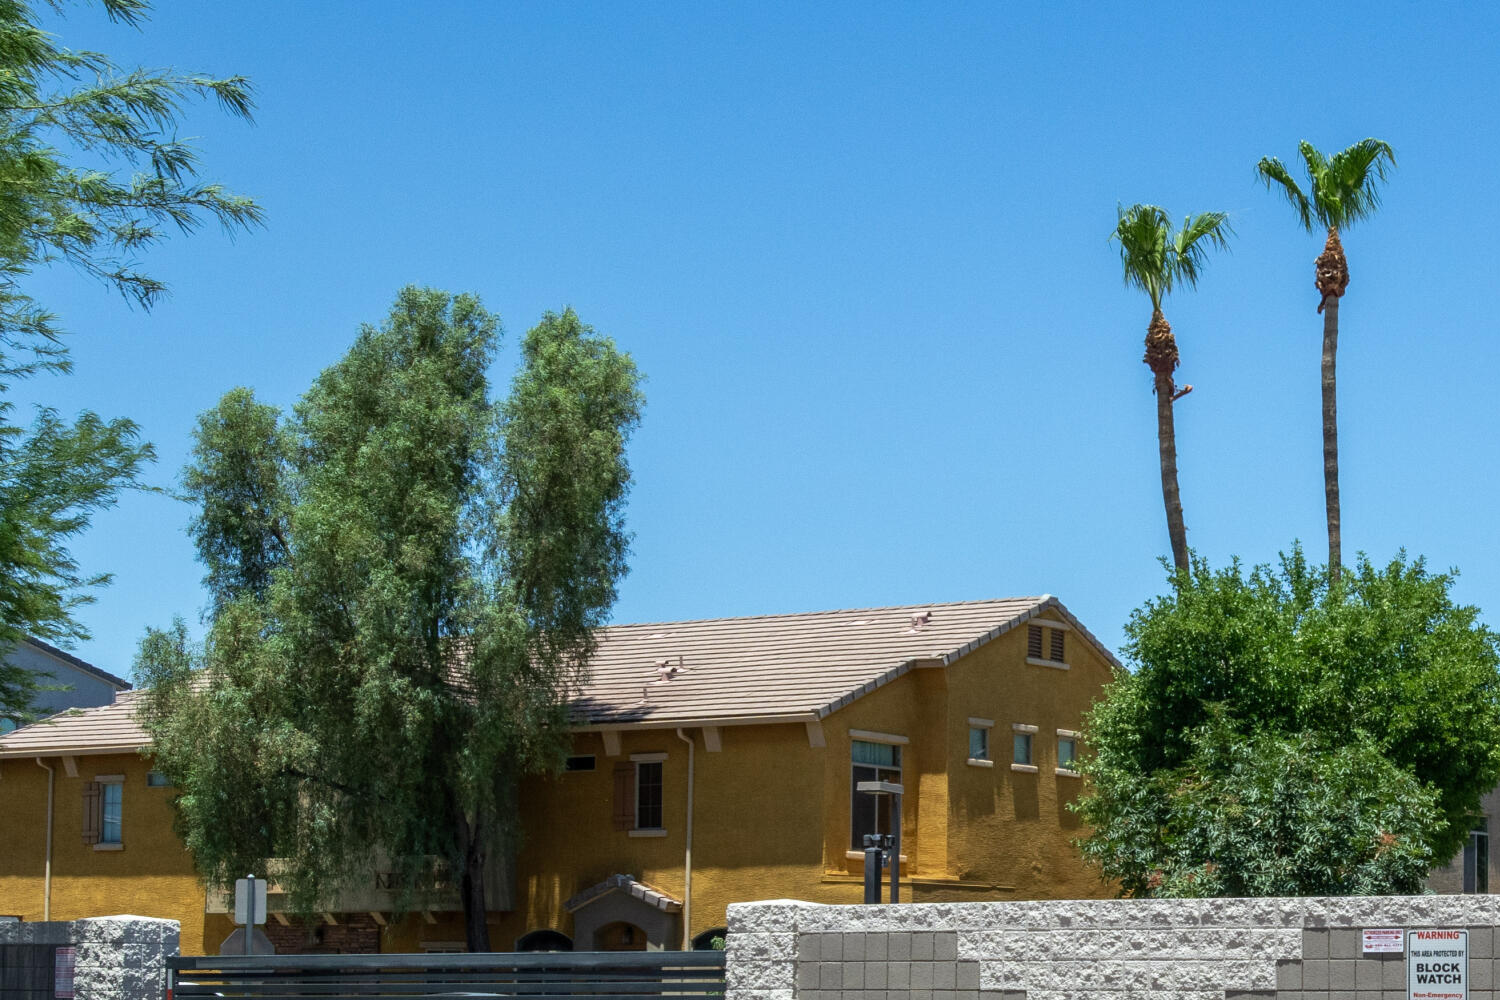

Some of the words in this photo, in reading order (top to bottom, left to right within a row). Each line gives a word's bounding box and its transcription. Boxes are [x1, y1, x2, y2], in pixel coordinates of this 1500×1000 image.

[1417, 931, 1460, 940] WARNING
[1416, 963, 1460, 973] BLOCK
[1416, 974, 1462, 984] WATCH
